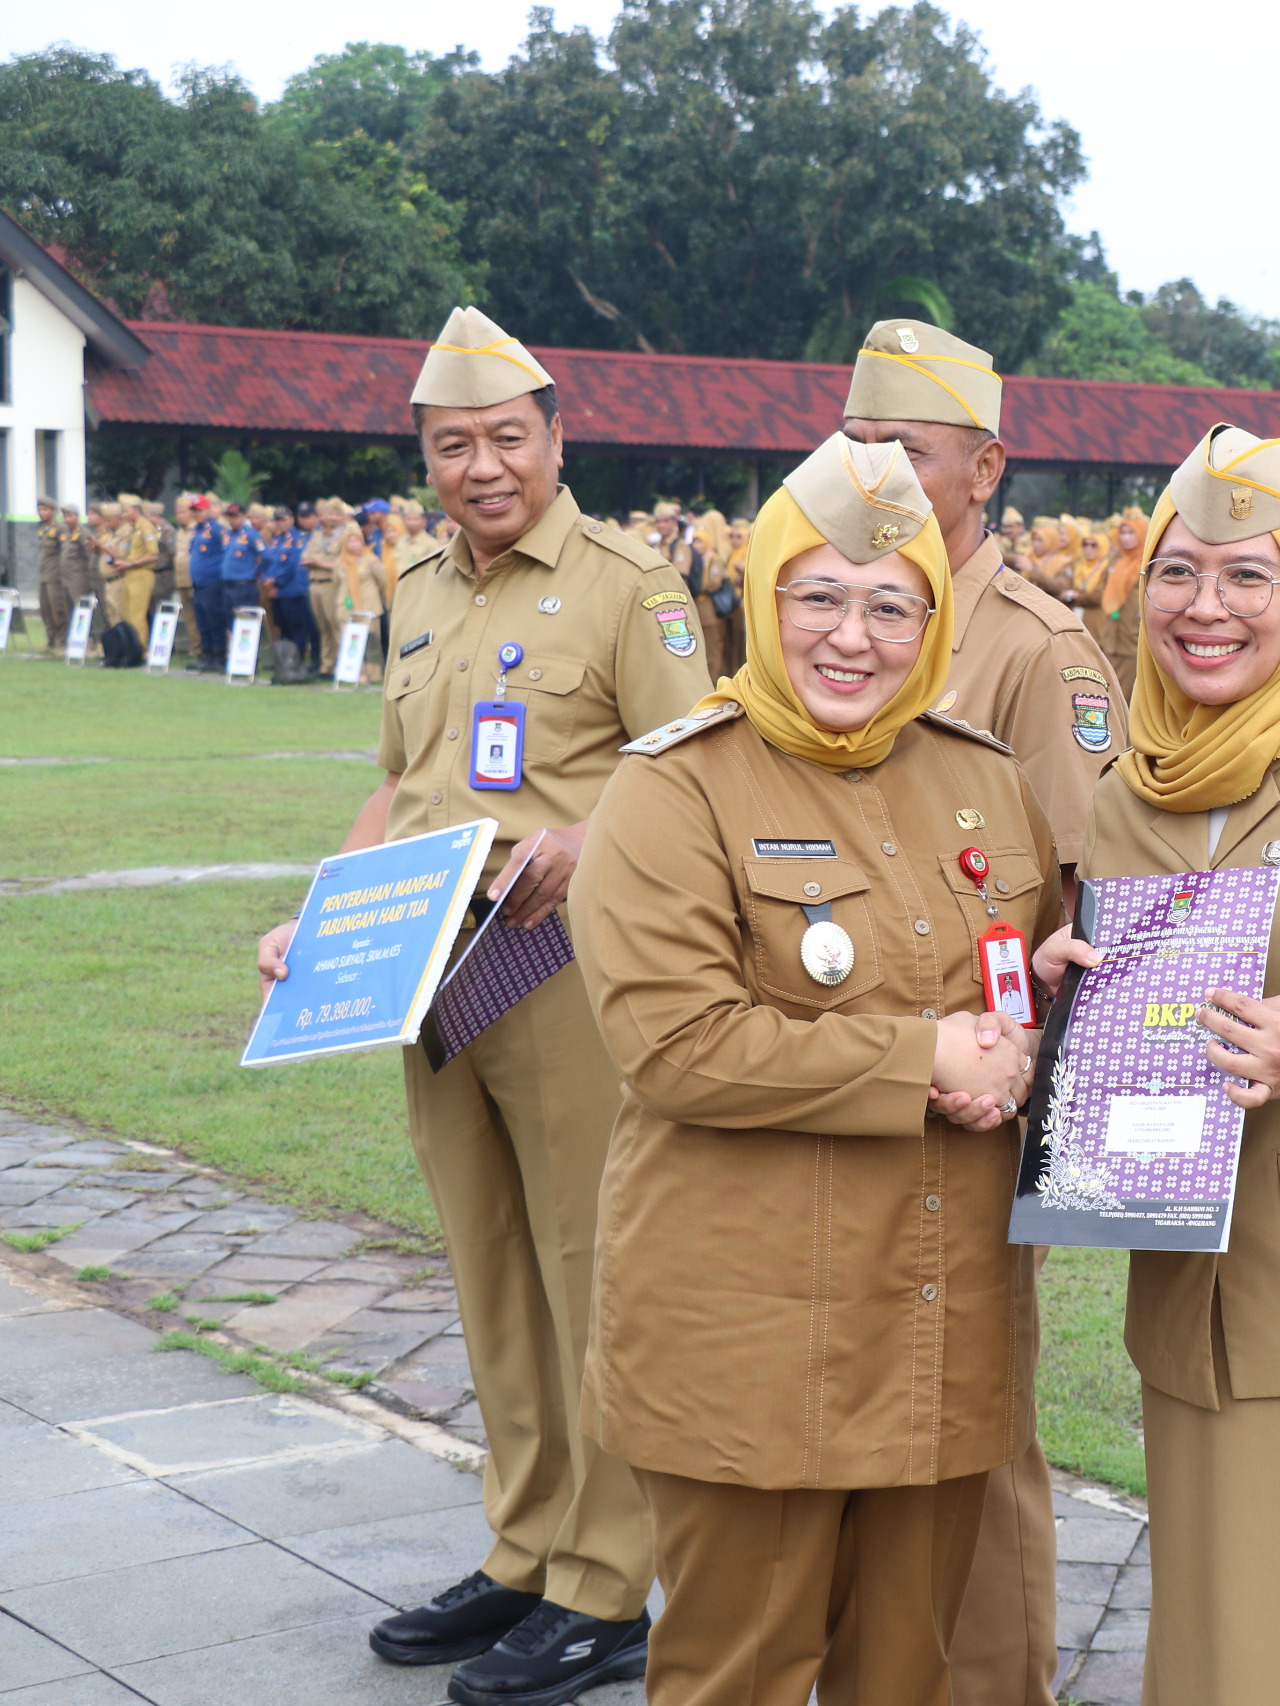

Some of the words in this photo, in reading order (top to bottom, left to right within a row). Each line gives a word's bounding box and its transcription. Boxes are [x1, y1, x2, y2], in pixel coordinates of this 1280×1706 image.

[758, 843, 779, 851] INTAN
[781, 843, 804, 851] NURUL
[805, 843, 832, 851] HIKMAH
[320, 882, 394, 914] PENYERAHAN
[391, 869, 450, 898] MANFAAT
[316, 909, 379, 938] TABUNGAN
[376, 903, 408, 926] HARI
[406, 898, 429, 919] TUA
[1196, 936, 1219, 945] SUMBER
[313, 957, 340, 972] AHMAD
[296, 1008, 312, 1031] Rp.
[1142, 1031, 1191, 1043] Kabupaten
